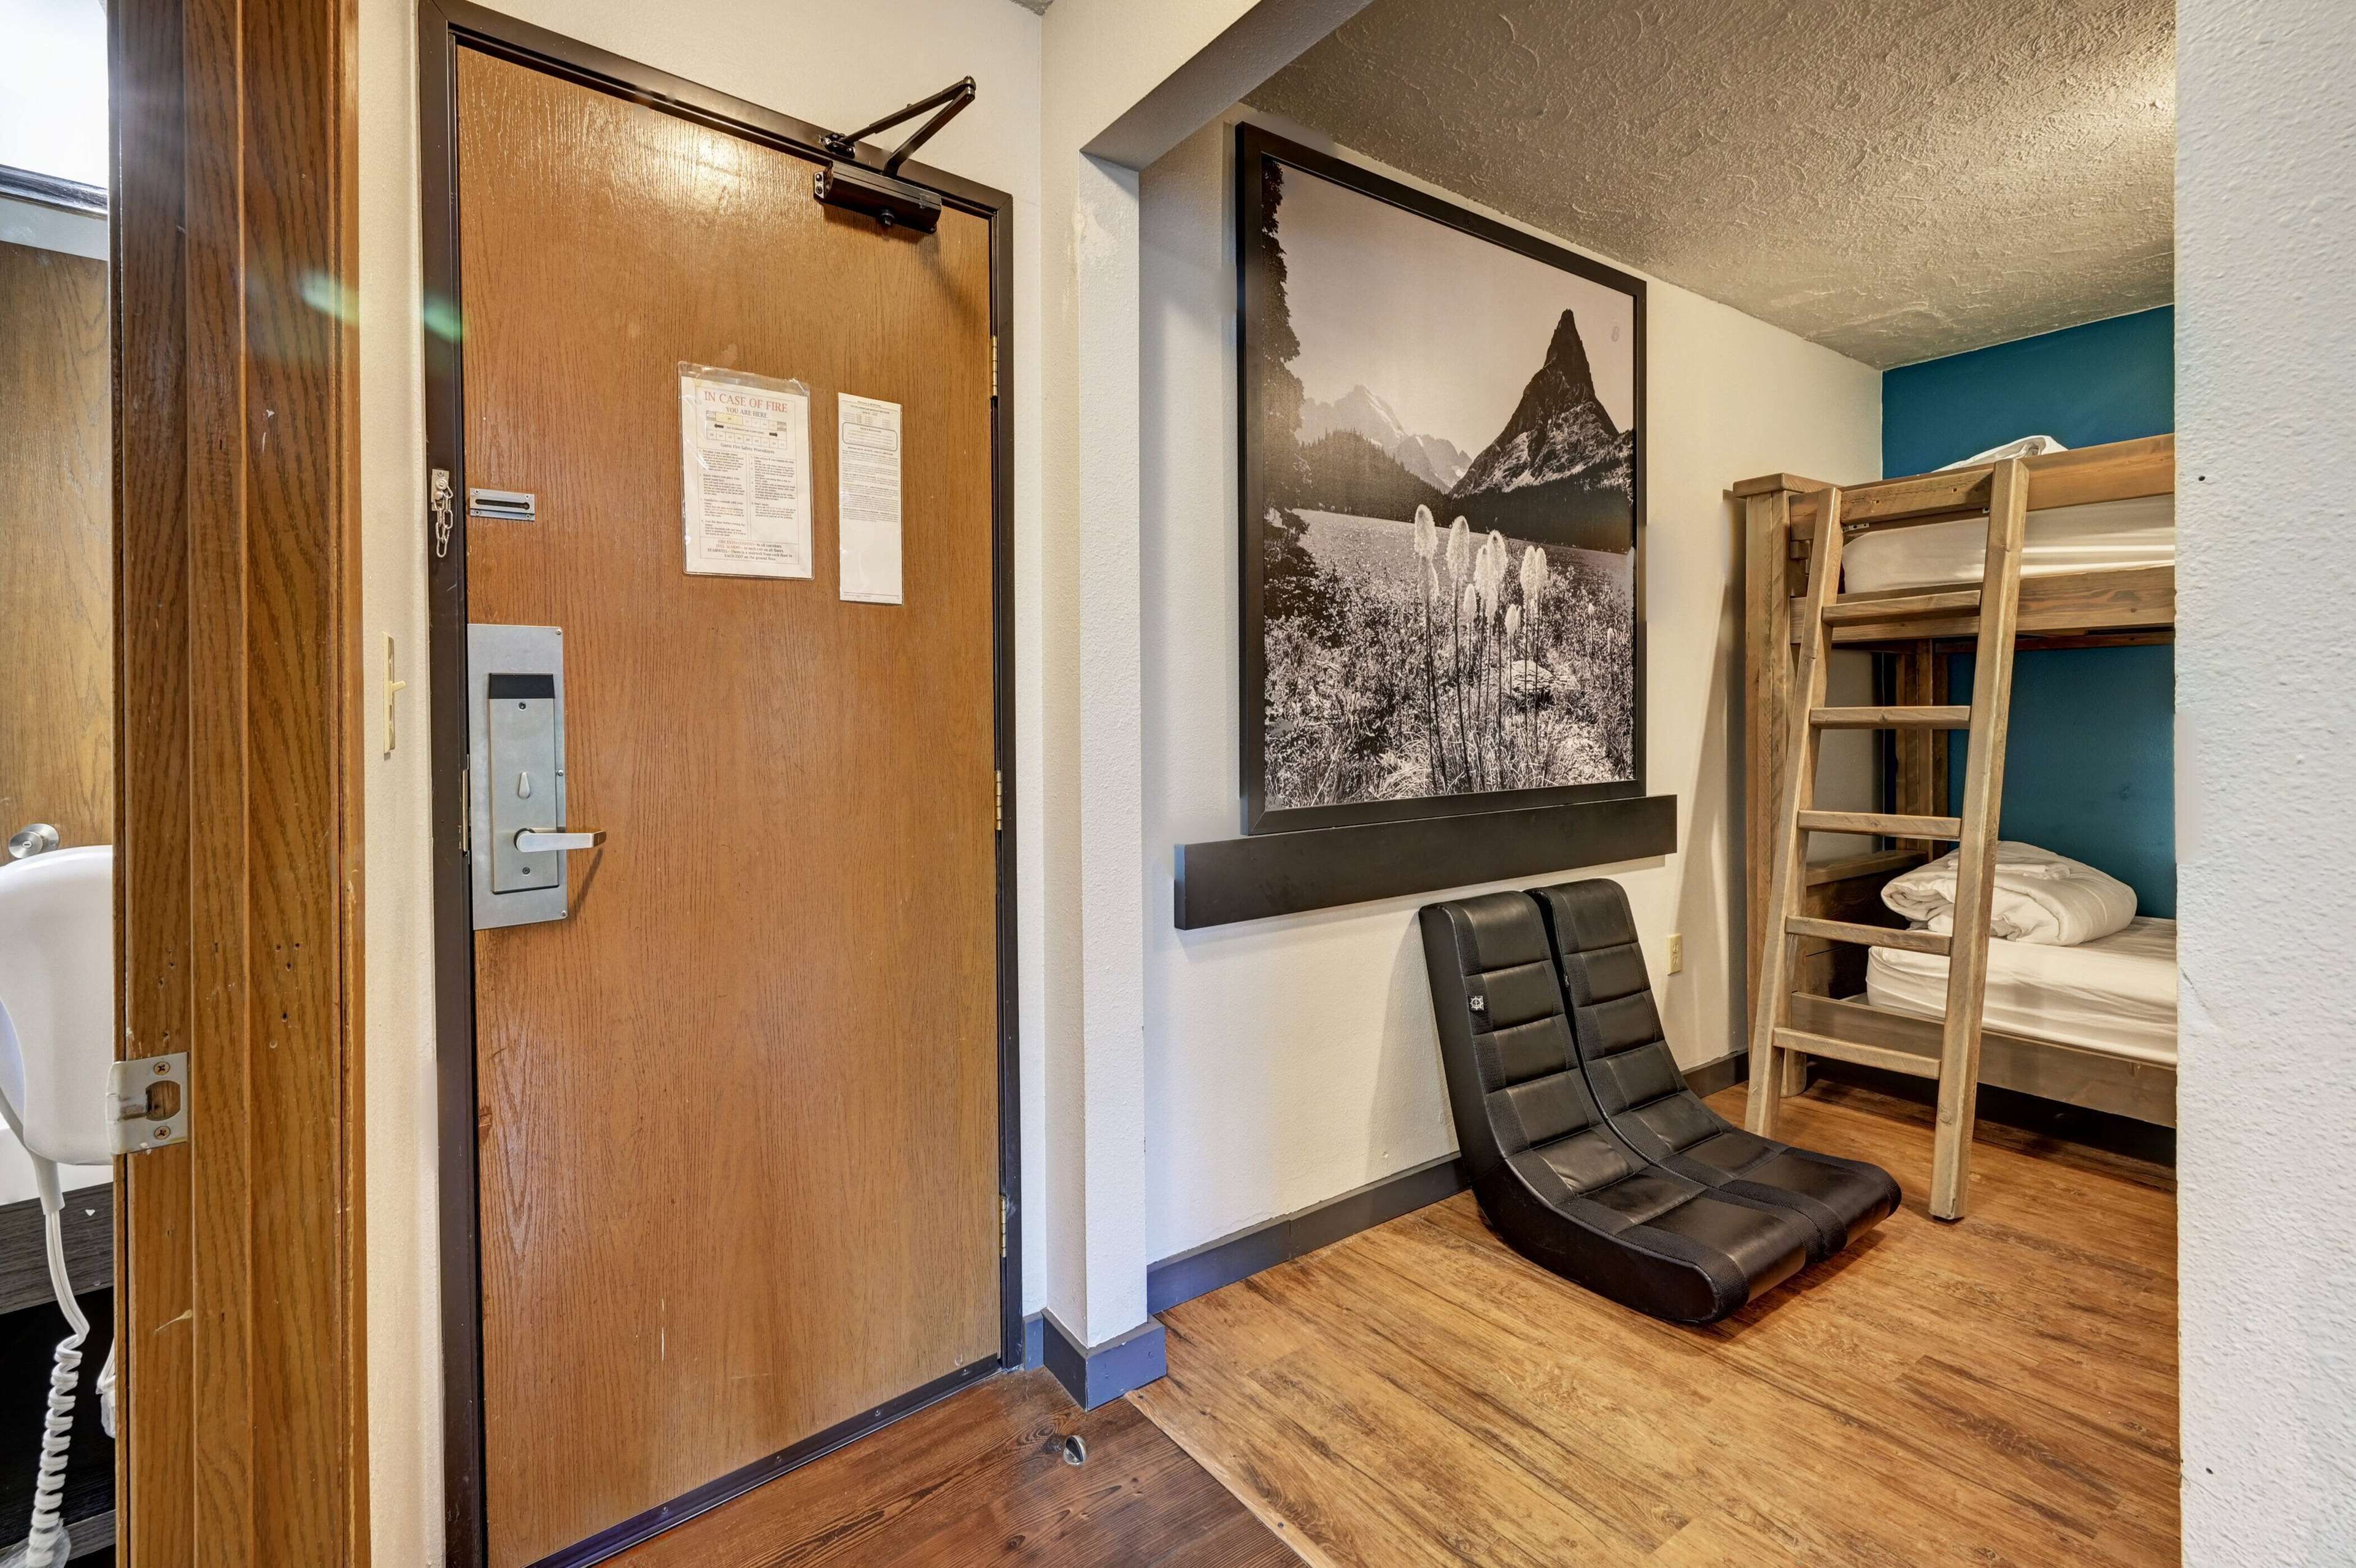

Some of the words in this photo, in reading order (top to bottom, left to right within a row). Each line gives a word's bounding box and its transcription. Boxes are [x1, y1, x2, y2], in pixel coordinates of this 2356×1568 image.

[704, 391, 716, 402] IN
[719, 393, 746, 406] CASE
[749, 398, 763, 409] OF
[766, 401, 787, 412] FIRE
